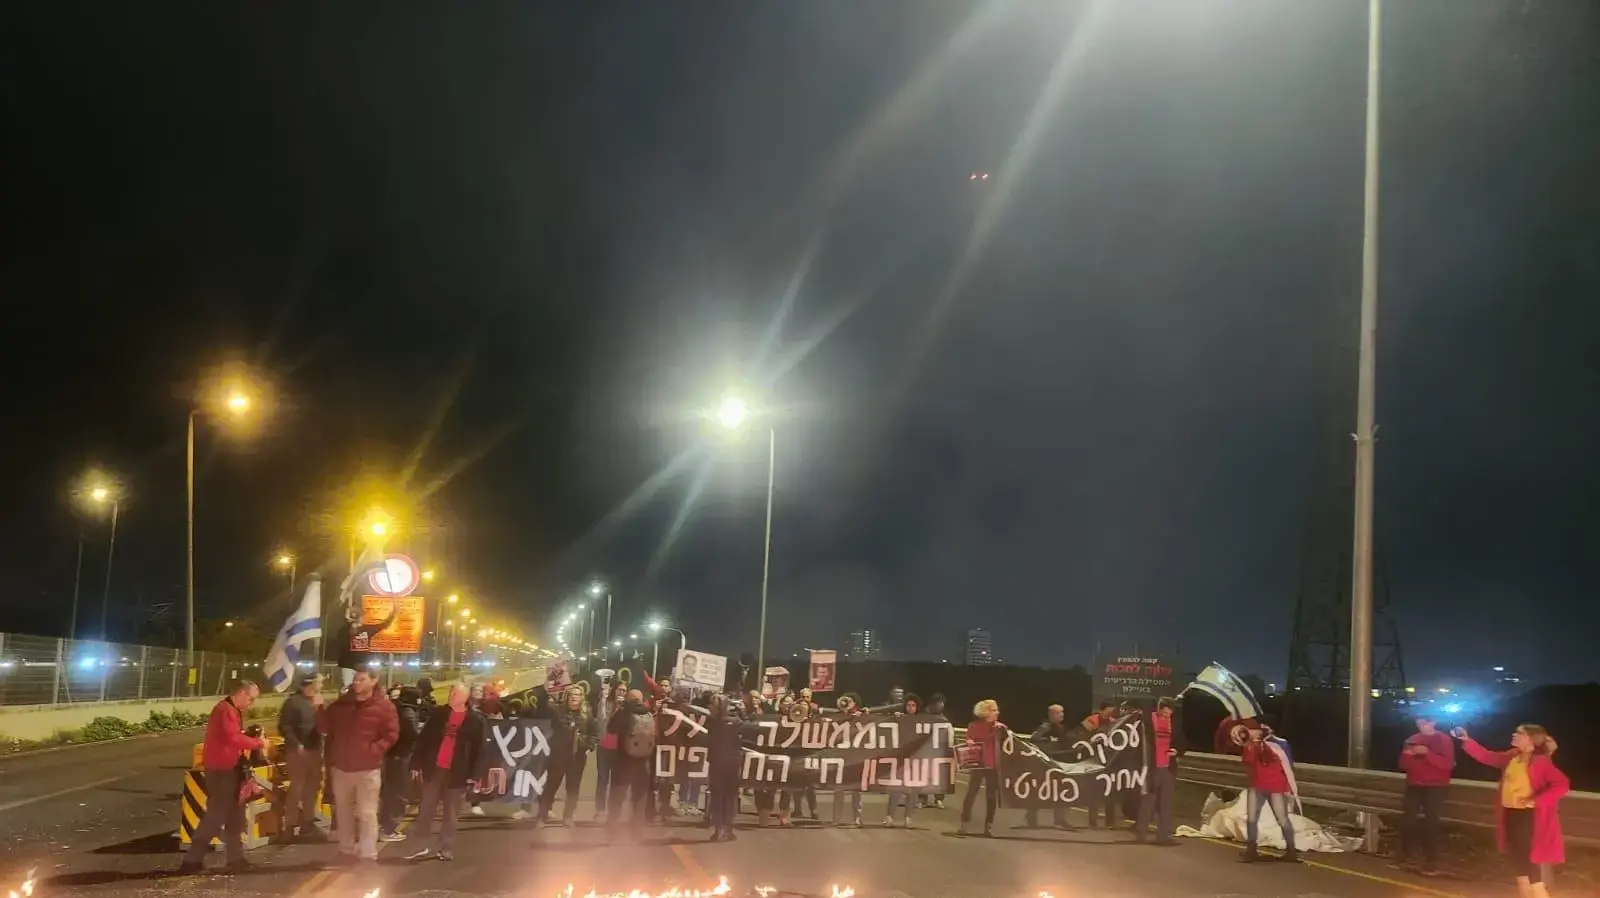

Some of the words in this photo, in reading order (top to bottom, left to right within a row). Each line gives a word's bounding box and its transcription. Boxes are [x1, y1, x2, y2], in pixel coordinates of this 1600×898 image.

[492, 725, 551, 767] גנץ
[757, 715, 899, 749] הממשלה
[915, 722, 955, 749] חיי
[1072, 719, 1142, 764] עסקה
[655, 744, 791, 783] החפים
[804, 757, 845, 784] חיי
[862, 757, 956, 791] חשבון
[1096, 765, 1148, 796] מחיר
[1005, 768, 1080, 802] פוליטי
